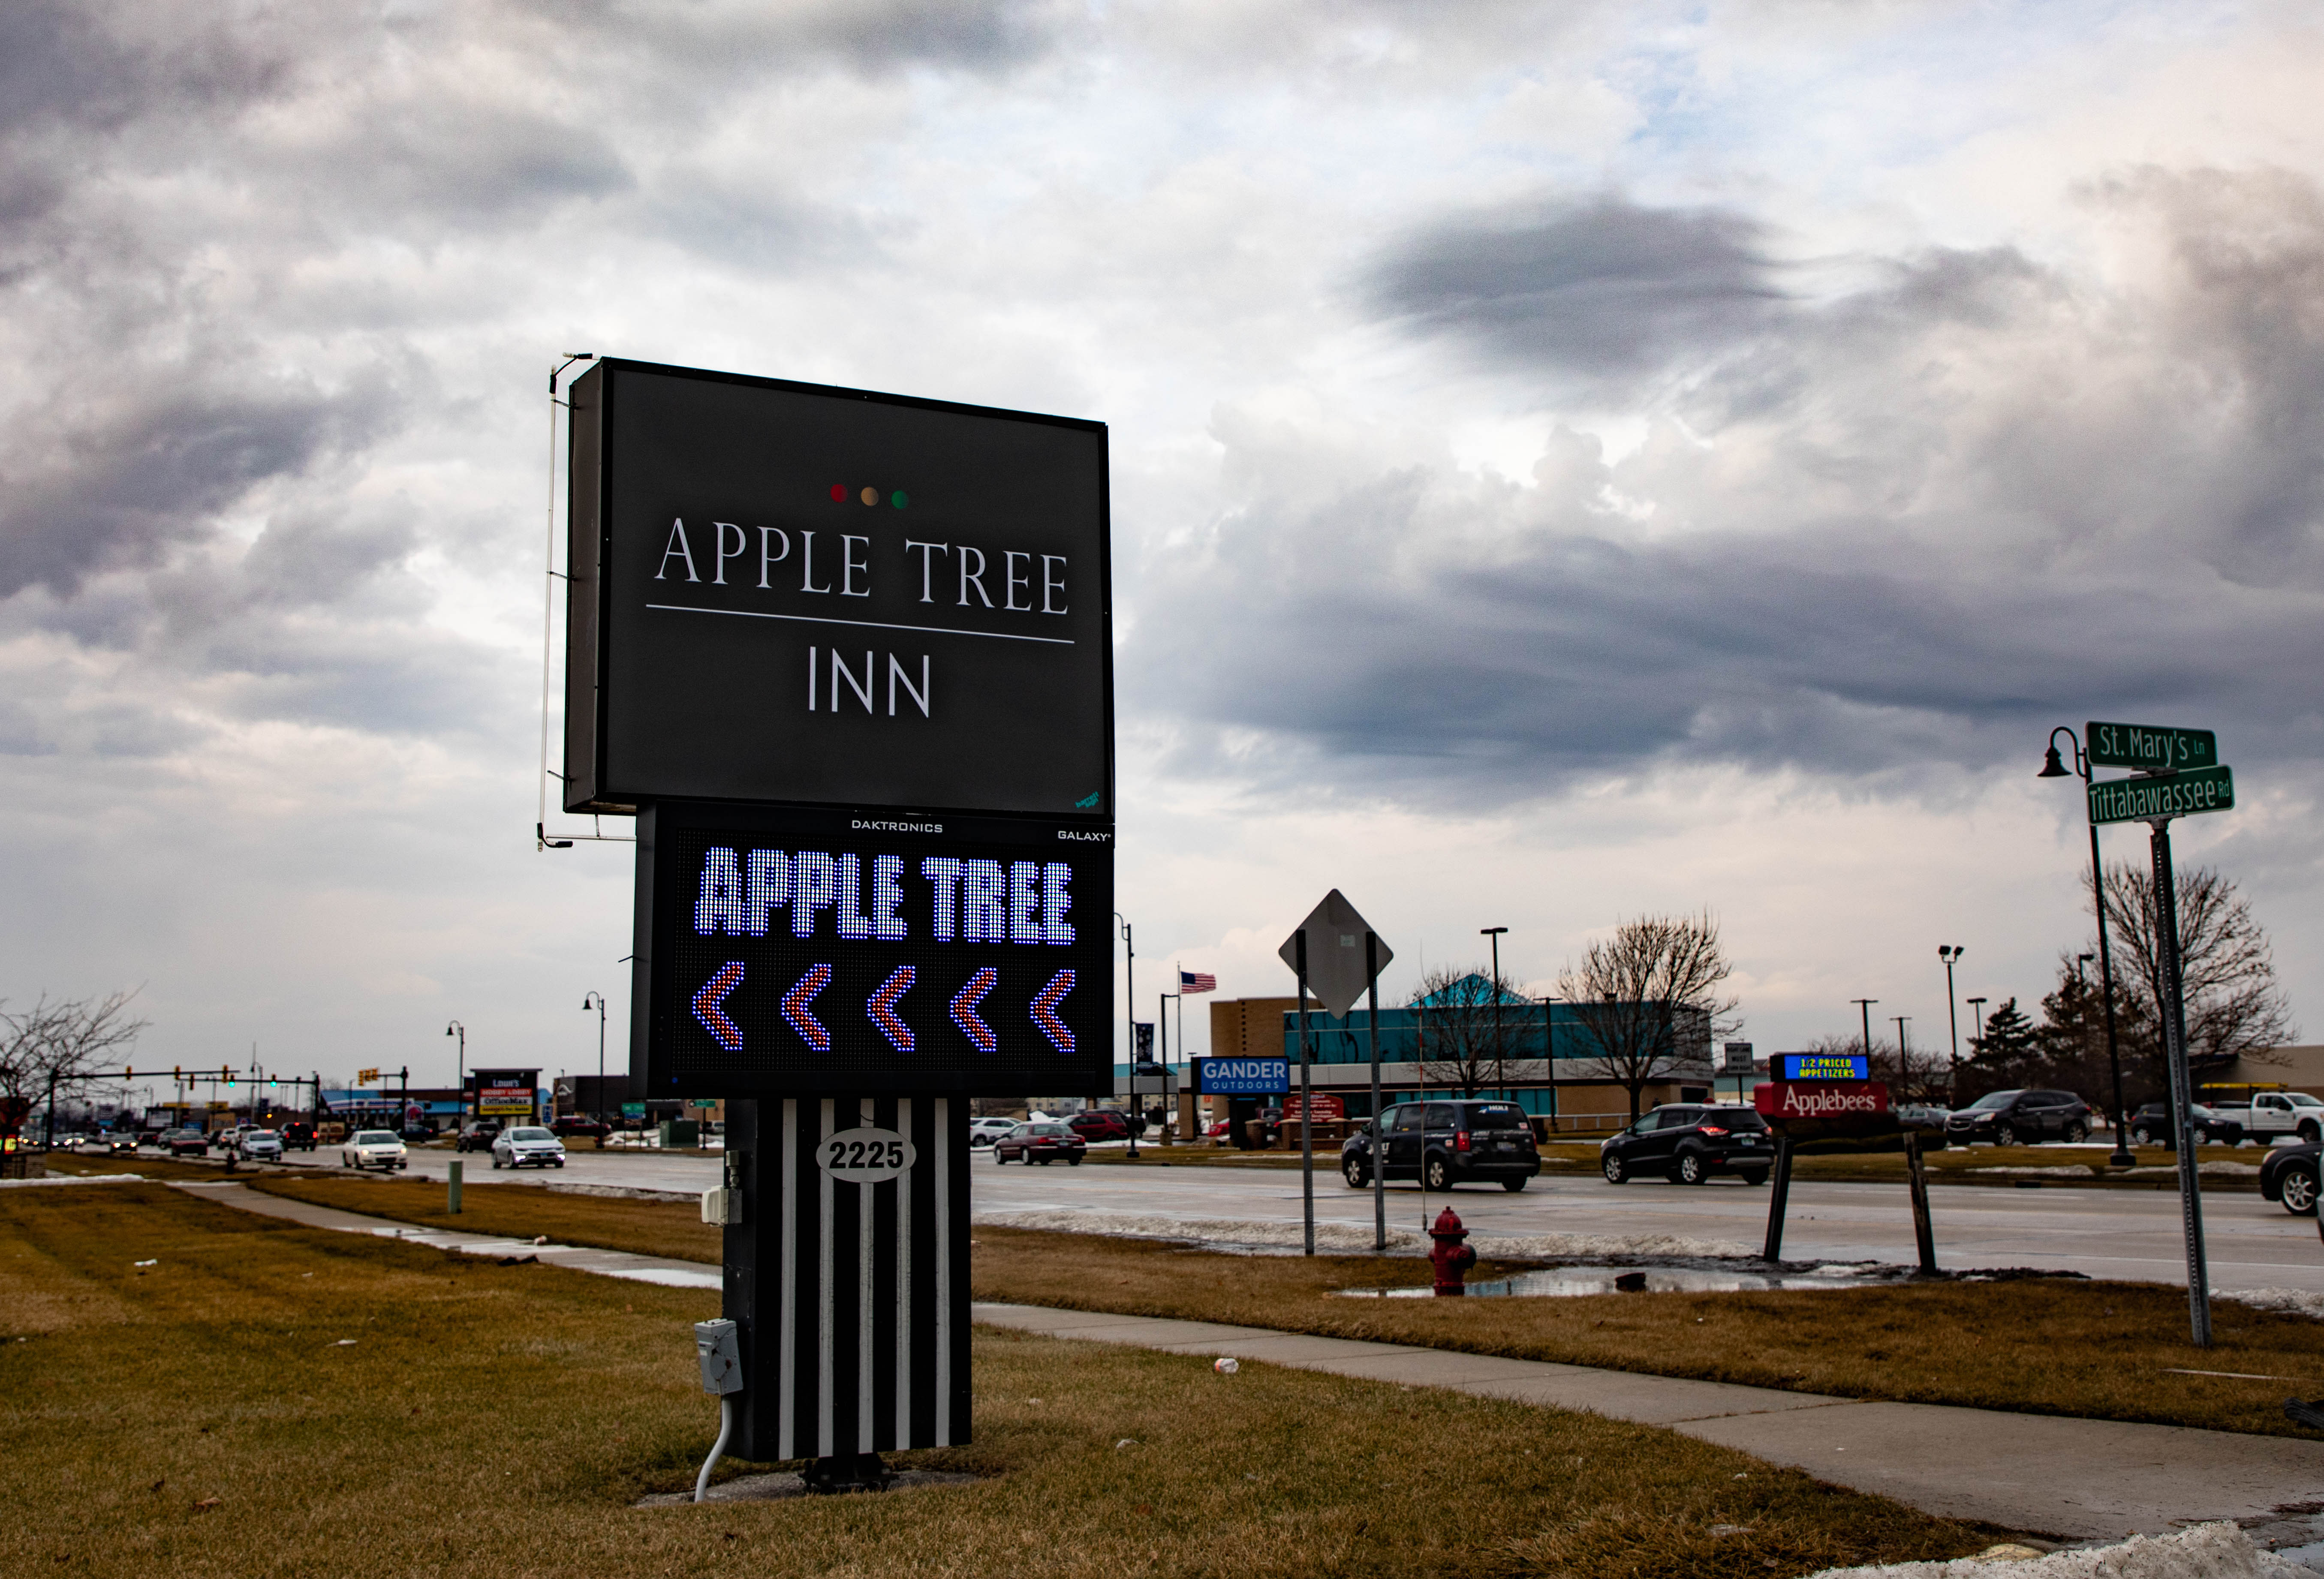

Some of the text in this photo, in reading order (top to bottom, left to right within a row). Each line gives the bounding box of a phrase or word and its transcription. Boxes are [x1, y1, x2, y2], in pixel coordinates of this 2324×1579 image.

[654, 517, 1068, 614] APPLE TREE
[809, 646, 929, 718] INN
[2100, 726, 2205, 767] St. Mary's Ln
[2089, 779, 2230, 821] Tittabawassee Rd
[852, 820, 942, 833] DAKTRONICS
[695, 847, 1076, 944] APPLE TREE
[1203, 1062, 1285, 1078] GANDER
[1799, 1069, 1855, 1078] APPETIZERS
[1800, 1058, 1851, 1068] 1/2 PRICED
[1212, 1081, 1279, 1089] OUTDOORS
[829, 1141, 903, 1169] 2225
